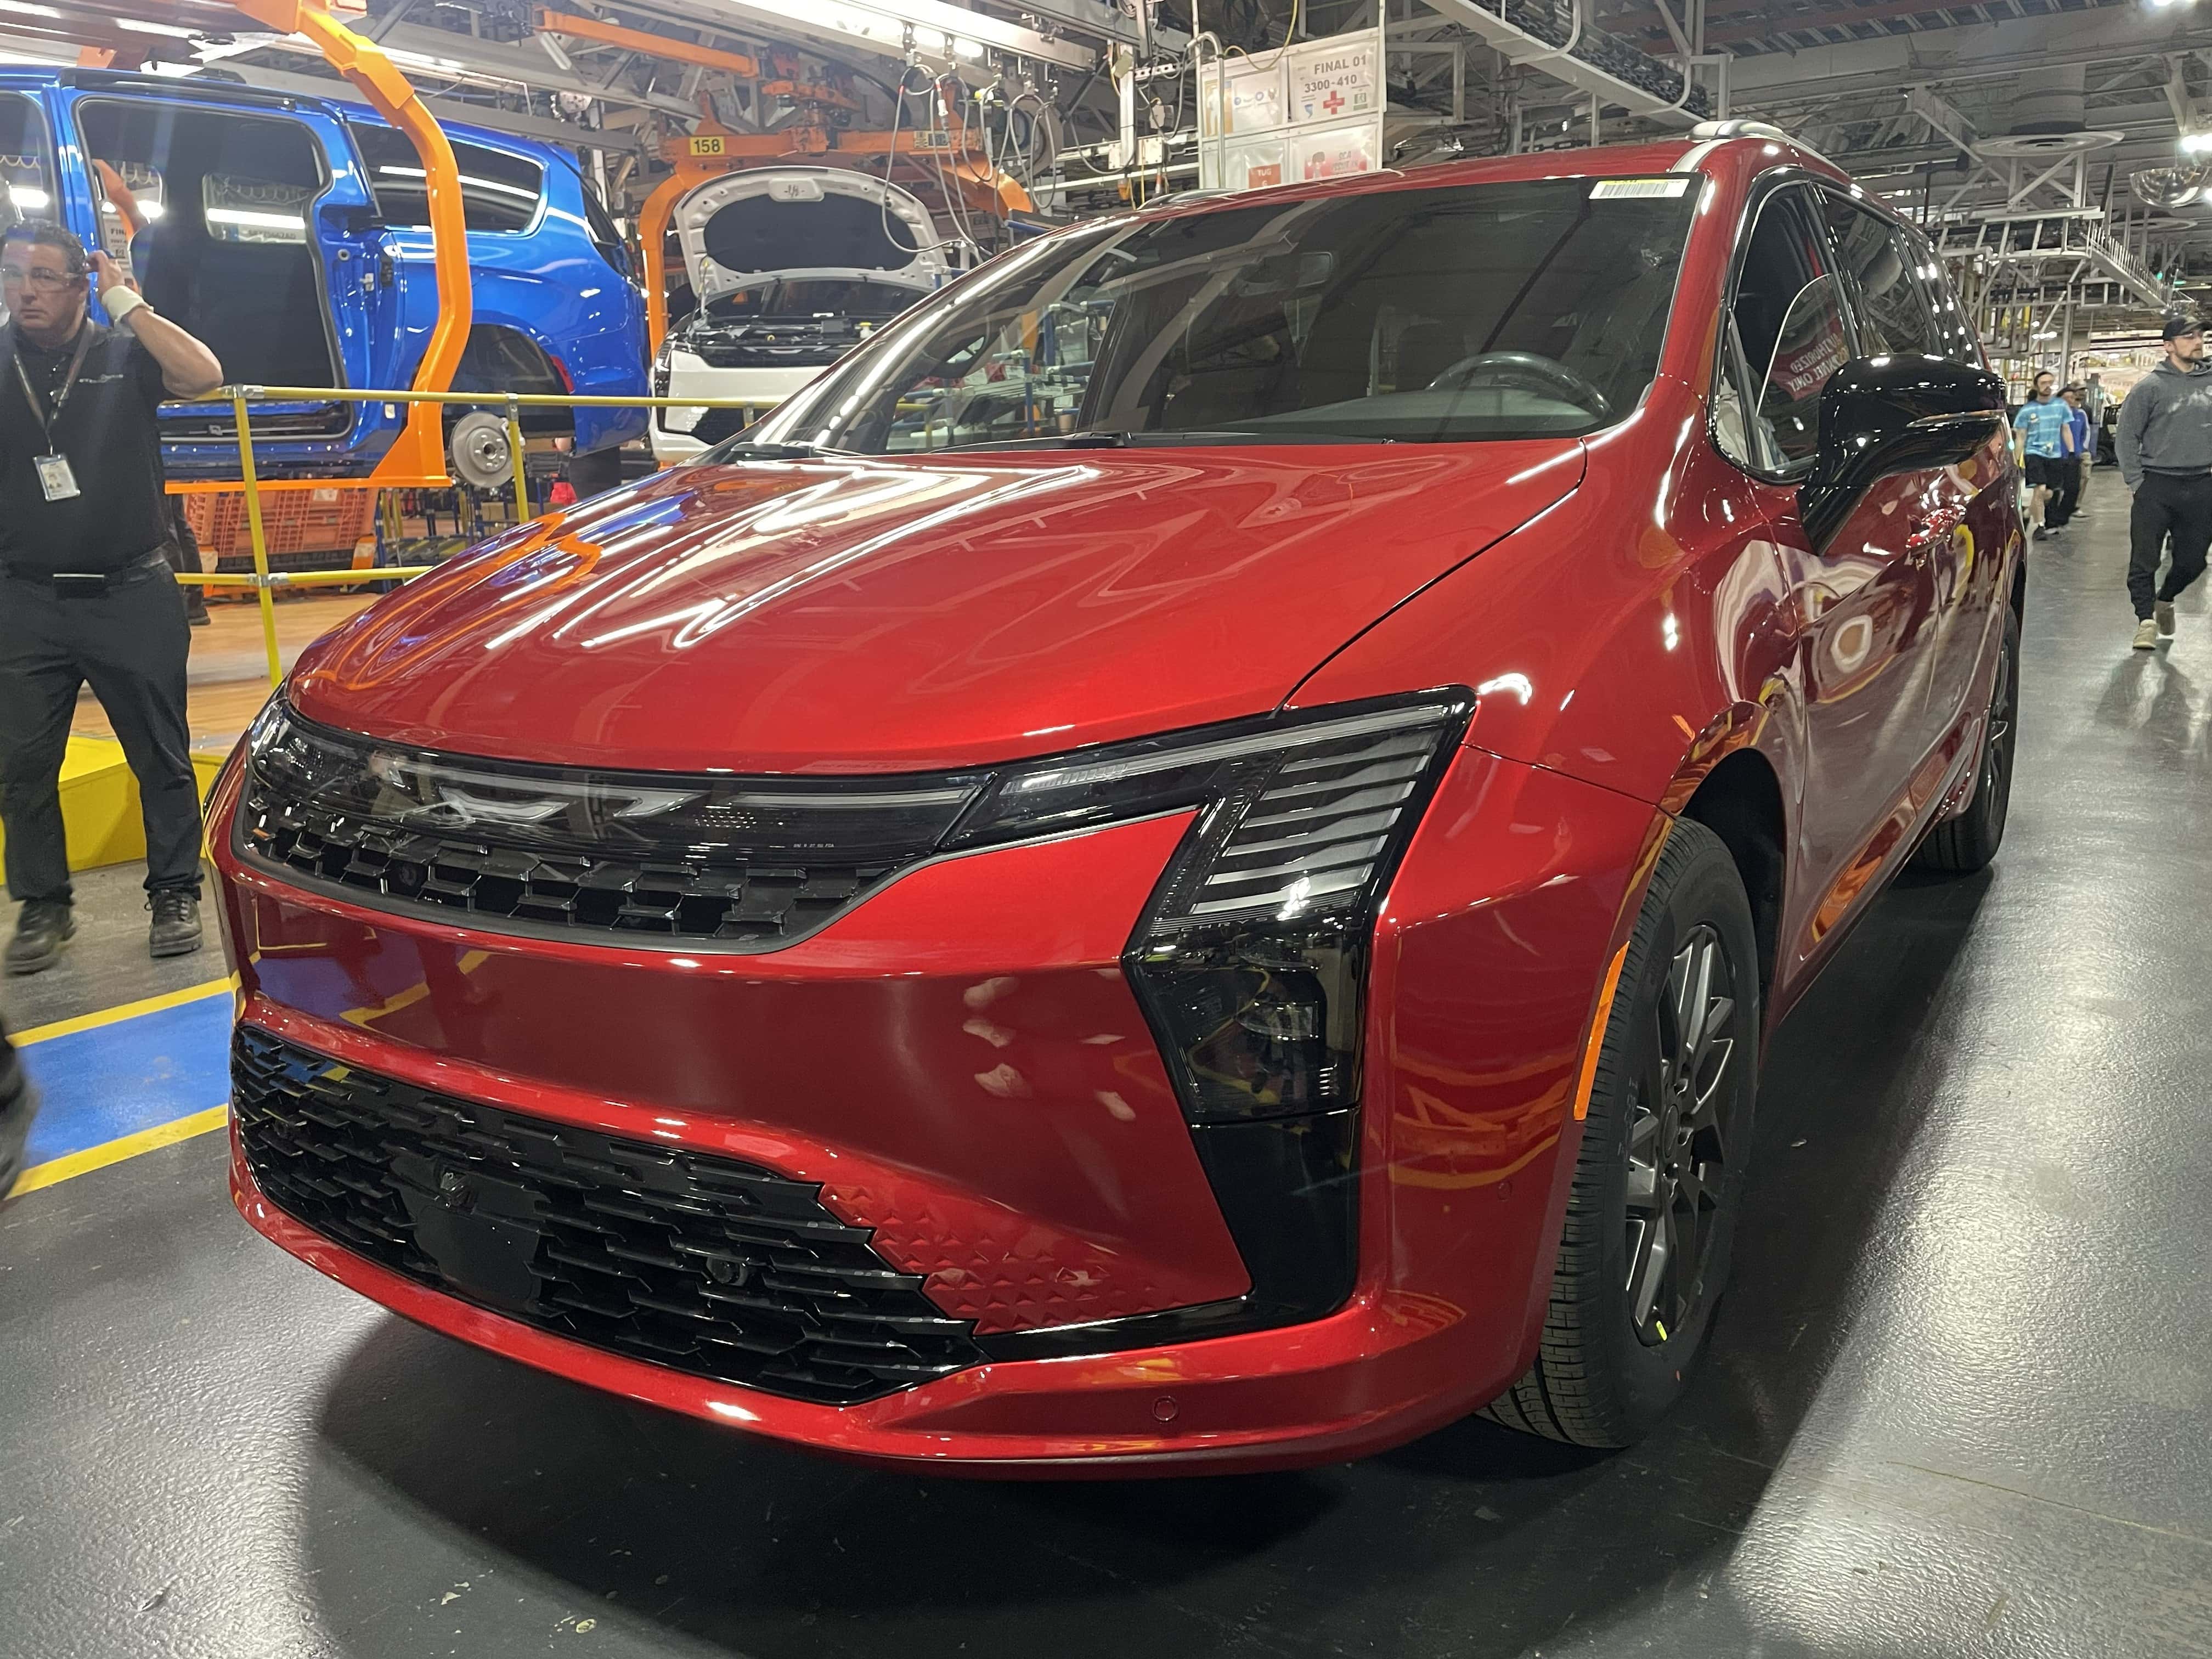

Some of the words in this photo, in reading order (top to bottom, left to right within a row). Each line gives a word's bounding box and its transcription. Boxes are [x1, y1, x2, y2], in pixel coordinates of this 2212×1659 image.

[1314, 59, 1350, 75] FINAL
[1353, 54, 1366, 67] 01
[1304, 74, 1357, 93] 3300-410
[693, 138, 720, 153] 158
[1257, 168, 1272, 176] TUG
[1180, 906, 1329, 932] CHRYSR
